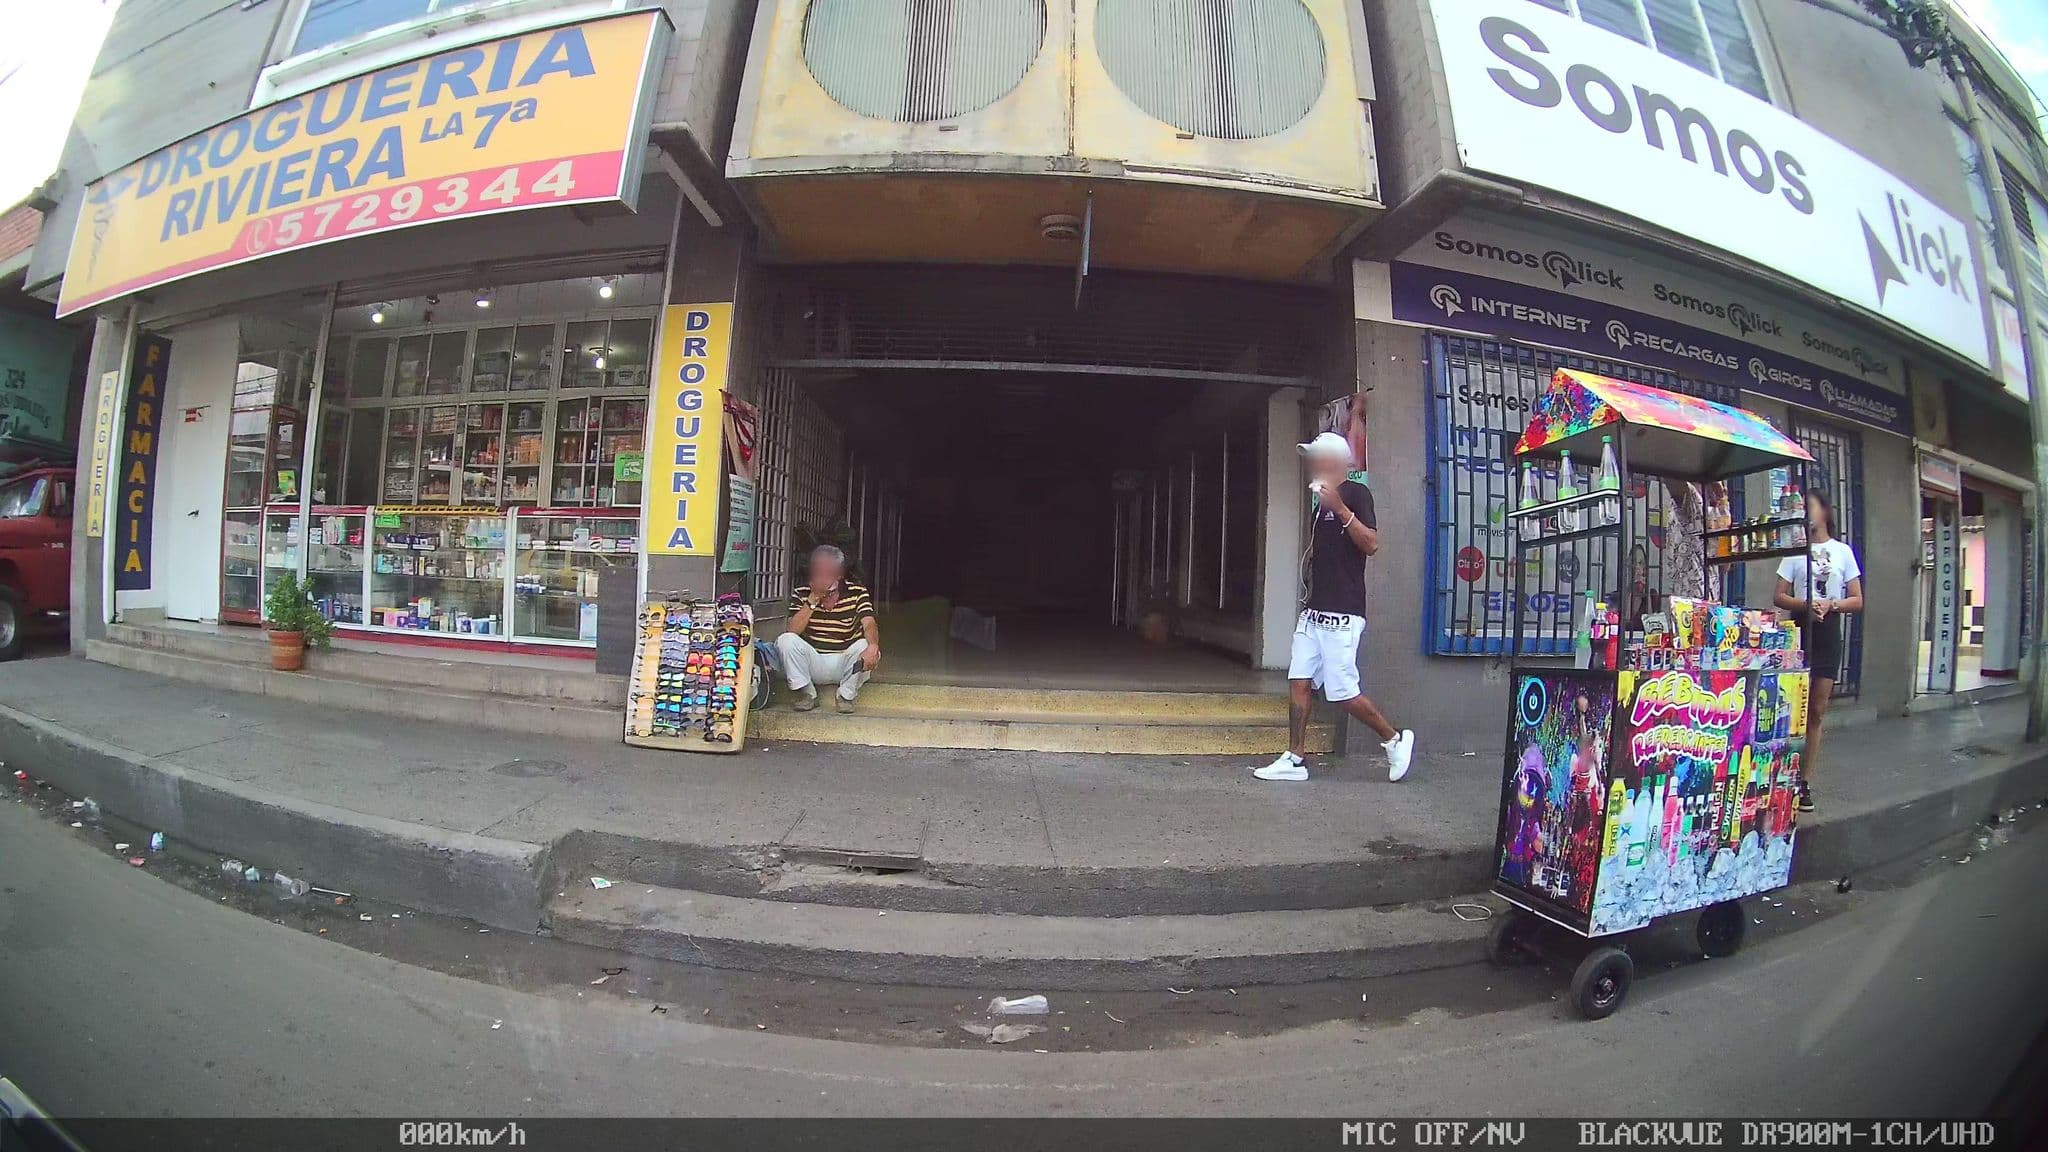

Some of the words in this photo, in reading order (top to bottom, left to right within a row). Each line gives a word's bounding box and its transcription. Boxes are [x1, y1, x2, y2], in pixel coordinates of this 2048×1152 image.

[135, 27, 596, 199] DROGUERIA
[160, 125, 406, 242] RIVIERA
[420, 118, 463, 144] LA
[1479, 15, 1814, 215] Somos
[274, 159, 577, 248] 5729344
[1471, 296, 1591, 334] INTERNET
[1633, 331, 1740, 371] RECARGAS
[1767, 368, 1813, 392] GIROS
[91, 377, 113, 533] DROGUERIA
[124, 343, 161, 573] FARMACIA
[668, 310, 711, 550] DROGUERIA
[1938, 530, 1952, 675] DROGUERIA
[1630, 671, 1747, 729] BEBIDAS
